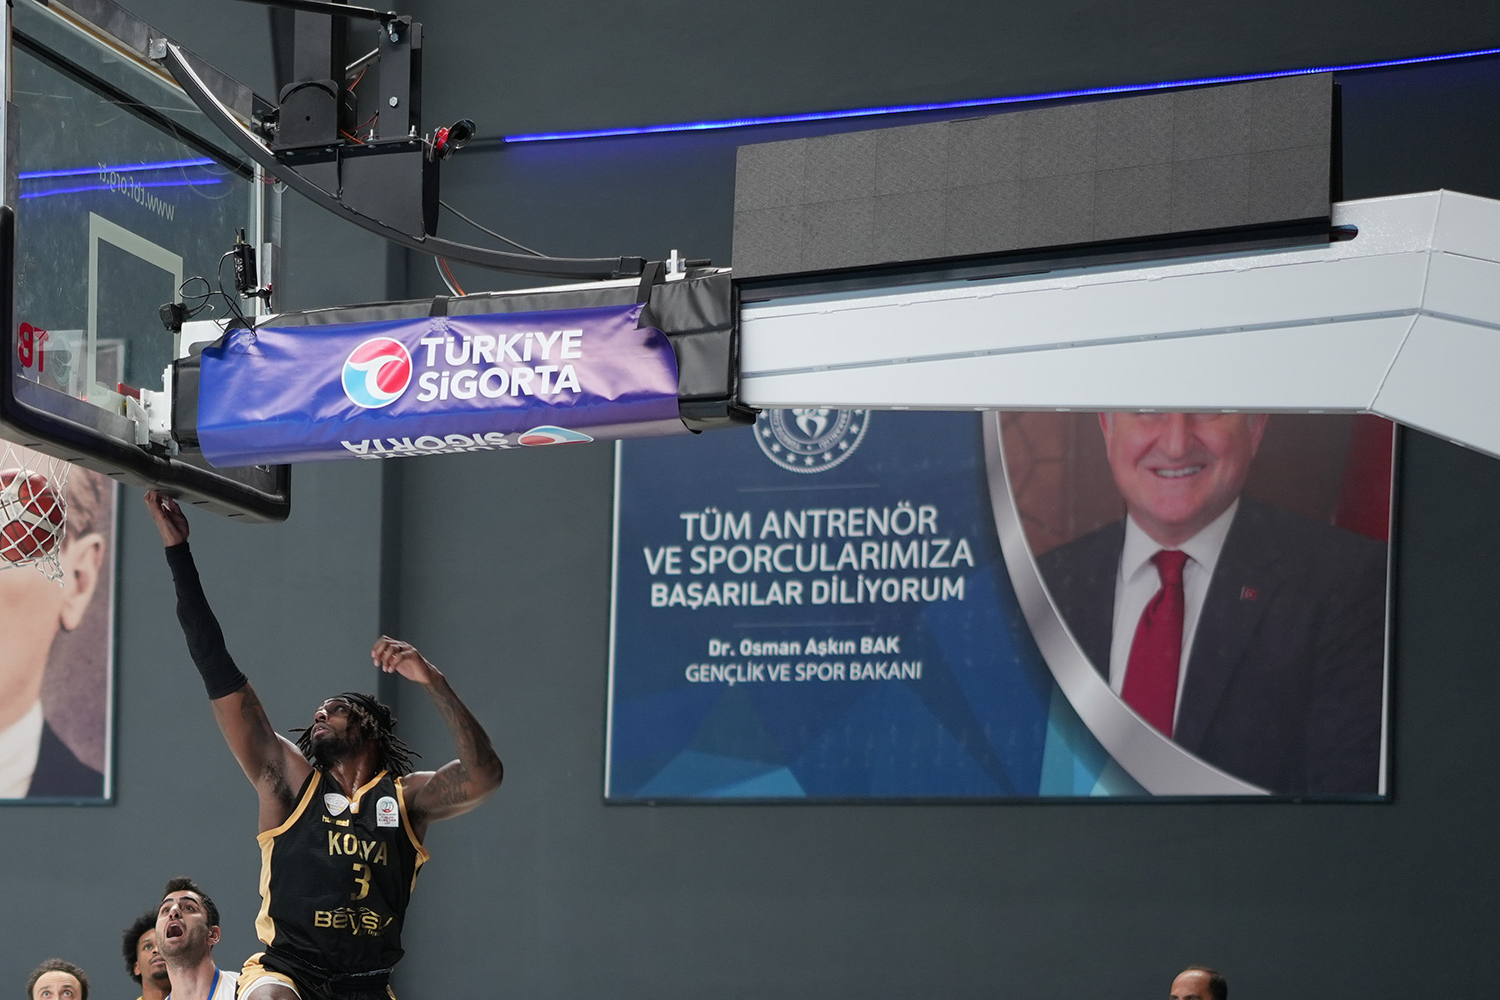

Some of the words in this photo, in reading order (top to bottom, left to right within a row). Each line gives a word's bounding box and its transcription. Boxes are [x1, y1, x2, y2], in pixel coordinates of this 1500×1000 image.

[680, 508, 751, 541] TÜM
[760, 501, 937, 538] ANTRENÖR
[644, 546, 682, 575] VE
[690, 538, 975, 574] SPORCULARIMIZA
[651, 581, 802, 610] BAŞARILAR
[811, 574, 965, 605] DİLİYORUM
[708, 640, 735, 656] Dr.
[740, 638, 800, 656] Osman
[804, 637, 855, 657] Aşkın
[860, 636, 900, 654] BAK
[685, 661, 764, 686] GENÇLİK
[769, 664, 791, 682] VE
[794, 661, 845, 682] SPOR
[849, 660, 922, 681] BAKANI
[350, 863, 372, 900] 3
